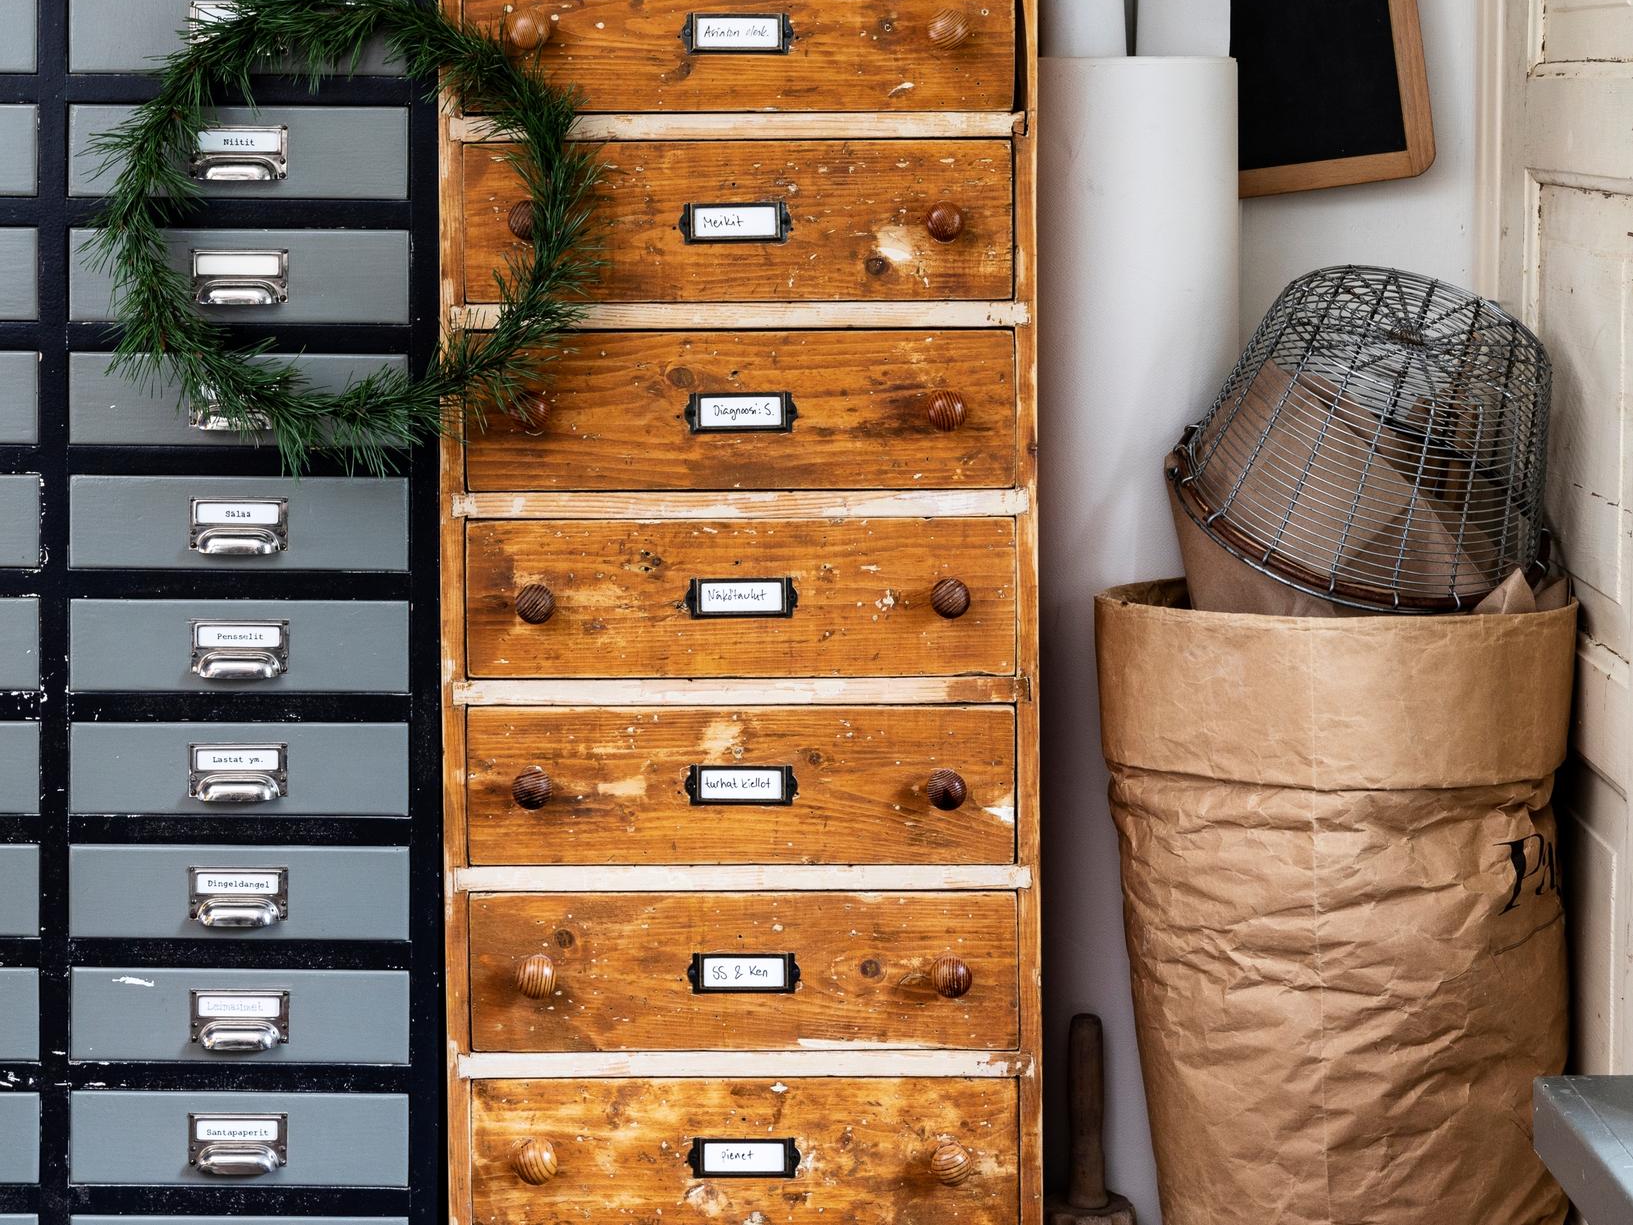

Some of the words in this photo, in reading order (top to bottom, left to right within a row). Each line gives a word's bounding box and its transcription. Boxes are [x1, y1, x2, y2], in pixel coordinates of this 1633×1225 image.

[703, 213, 744, 229] Meikit
[217, 633, 264, 641] Pensselit
[207, 879, 270, 889] Dingeldangel
[712, 965, 728, 980] SS
[734, 965, 743, 980] &
[206, 1128, 269, 1137] Santapaperit
